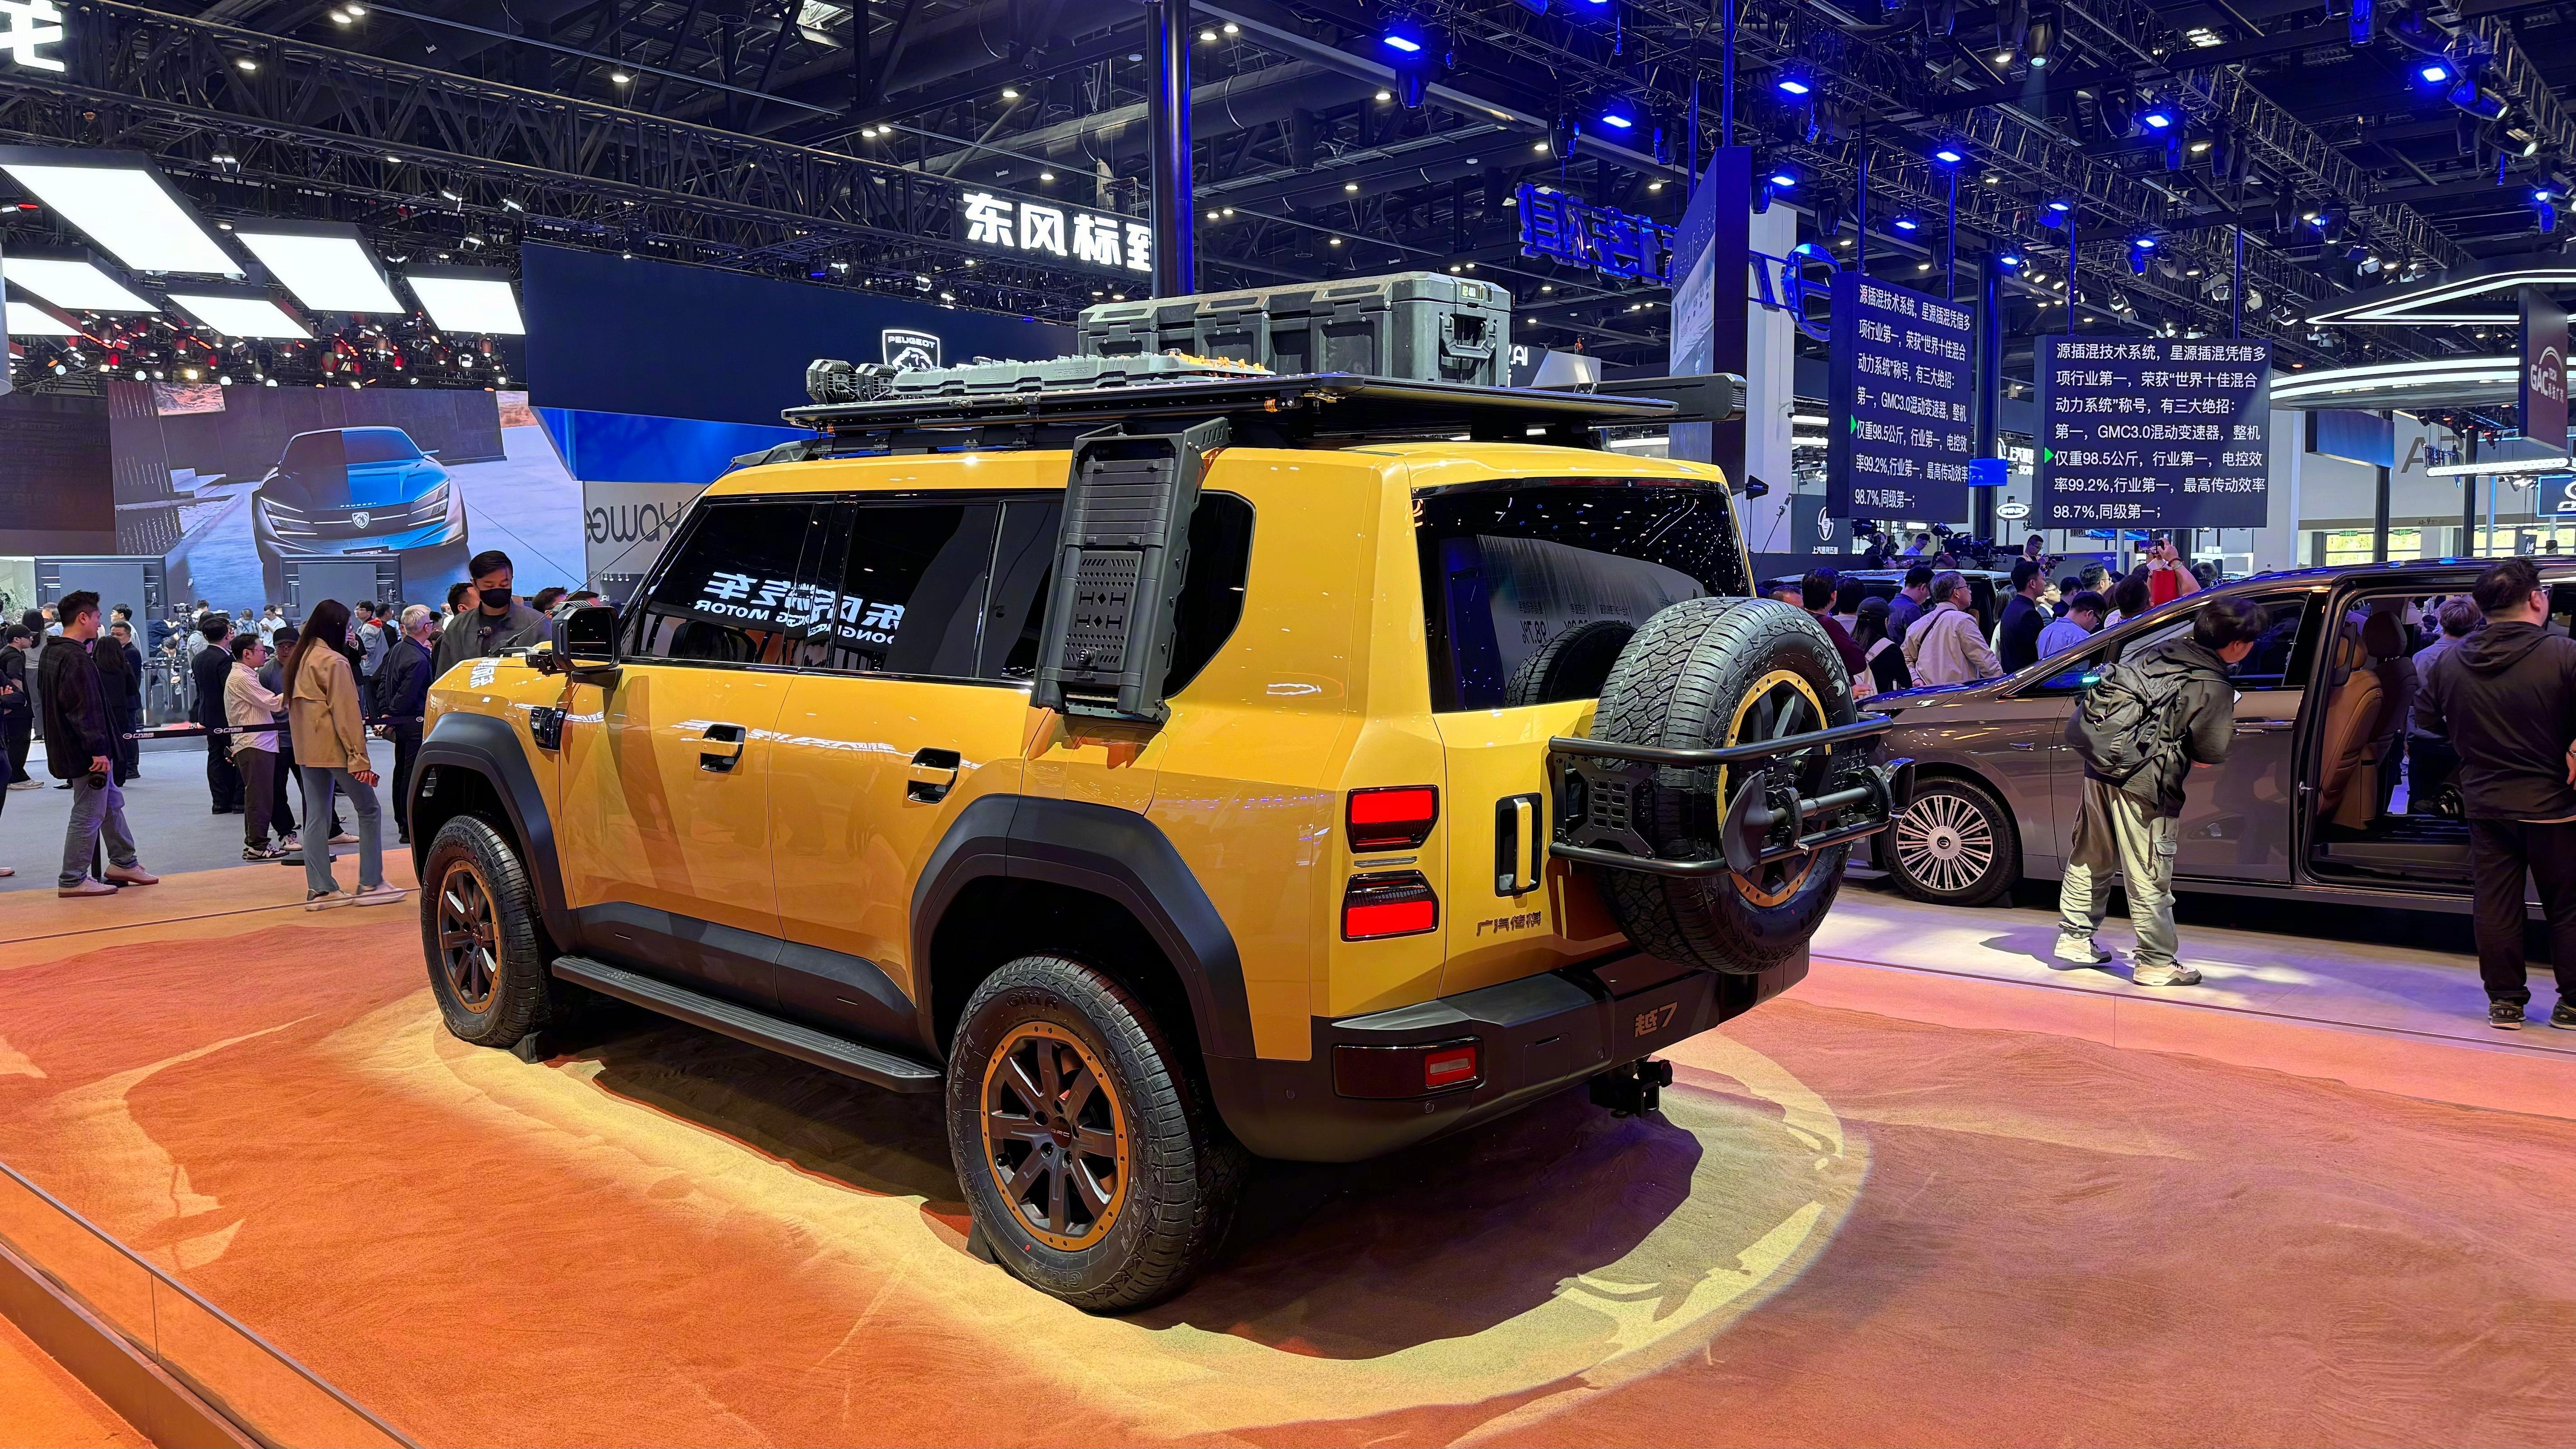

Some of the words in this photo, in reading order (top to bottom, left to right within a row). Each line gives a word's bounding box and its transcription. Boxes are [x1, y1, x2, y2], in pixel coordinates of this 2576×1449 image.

[888, 336, 935, 349] PEUGEOT
[2530, 364, 2548, 396] GAC
[1812, 645, 1838, 681] Giti
[1476, 911, 1541, 937] 广汽传祺
[1007, 990, 1042, 1008] Giti
[1634, 1002, 1678, 1038] 越7
